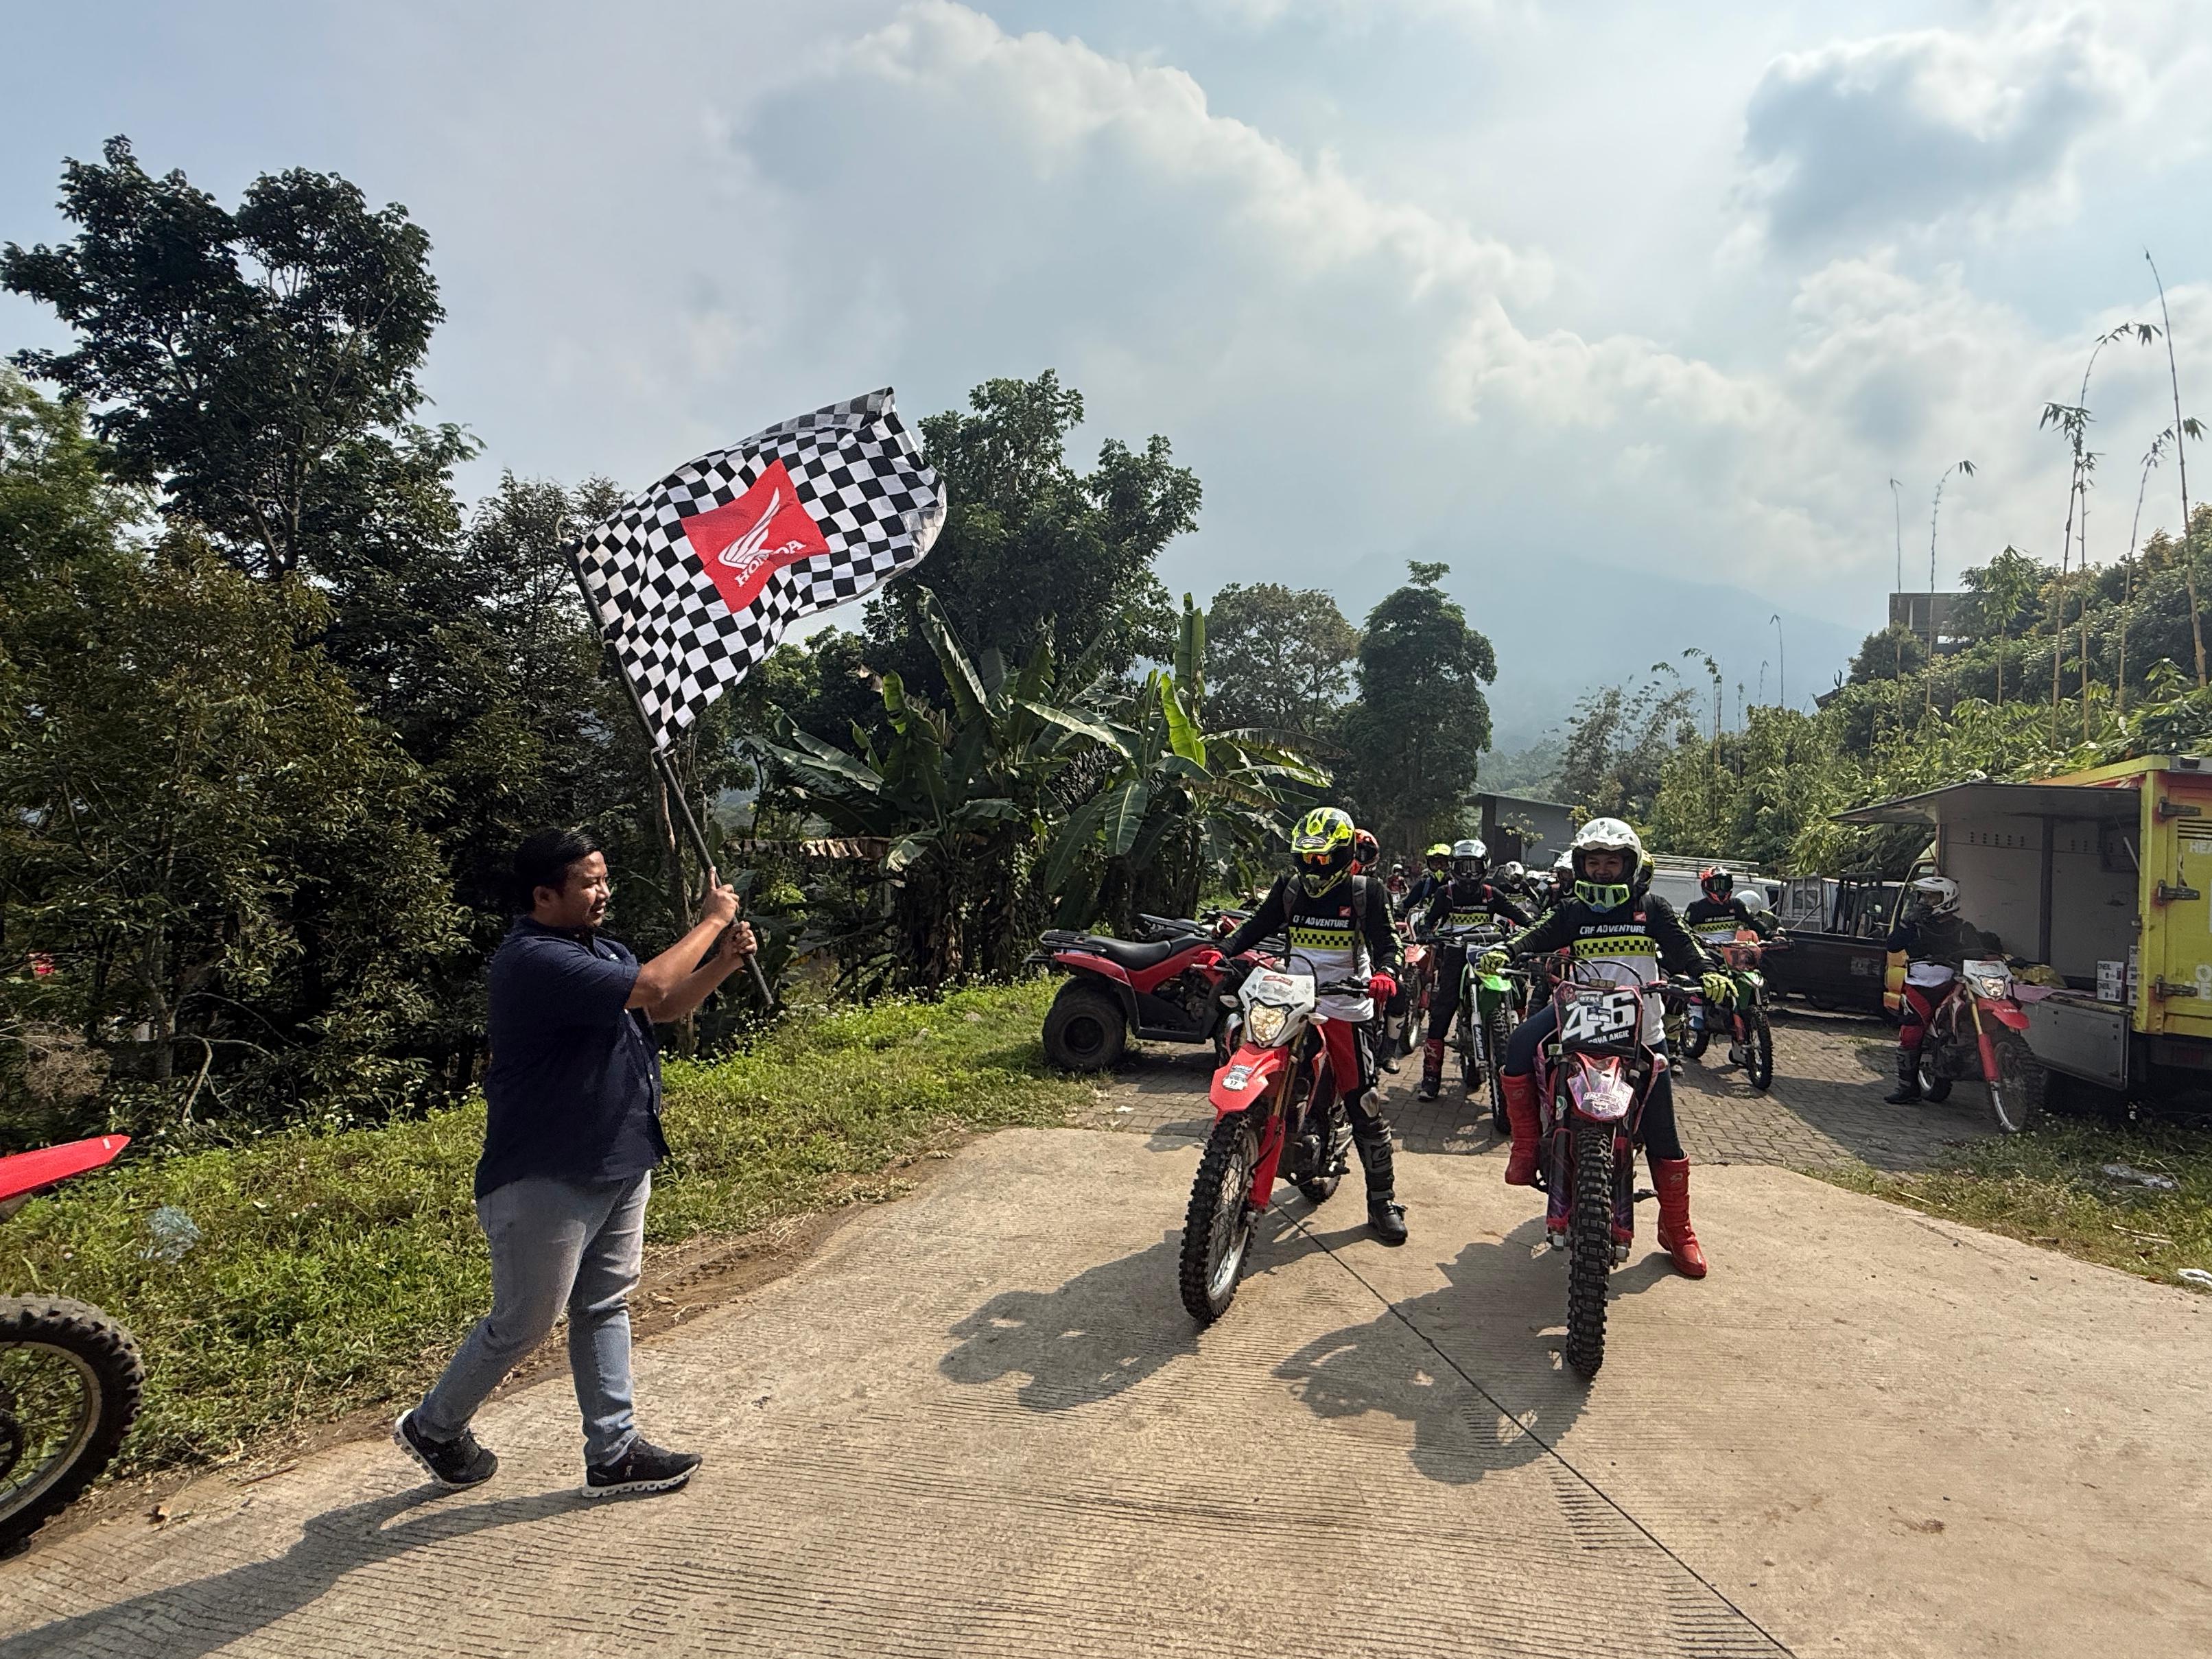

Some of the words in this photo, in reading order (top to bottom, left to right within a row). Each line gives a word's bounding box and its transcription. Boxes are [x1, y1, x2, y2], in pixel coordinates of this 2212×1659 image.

[1305, 917, 1350, 928] ADVENTURE
[1579, 926, 1595, 935] CRF
[1596, 924, 1646, 934] ADVENTURE
